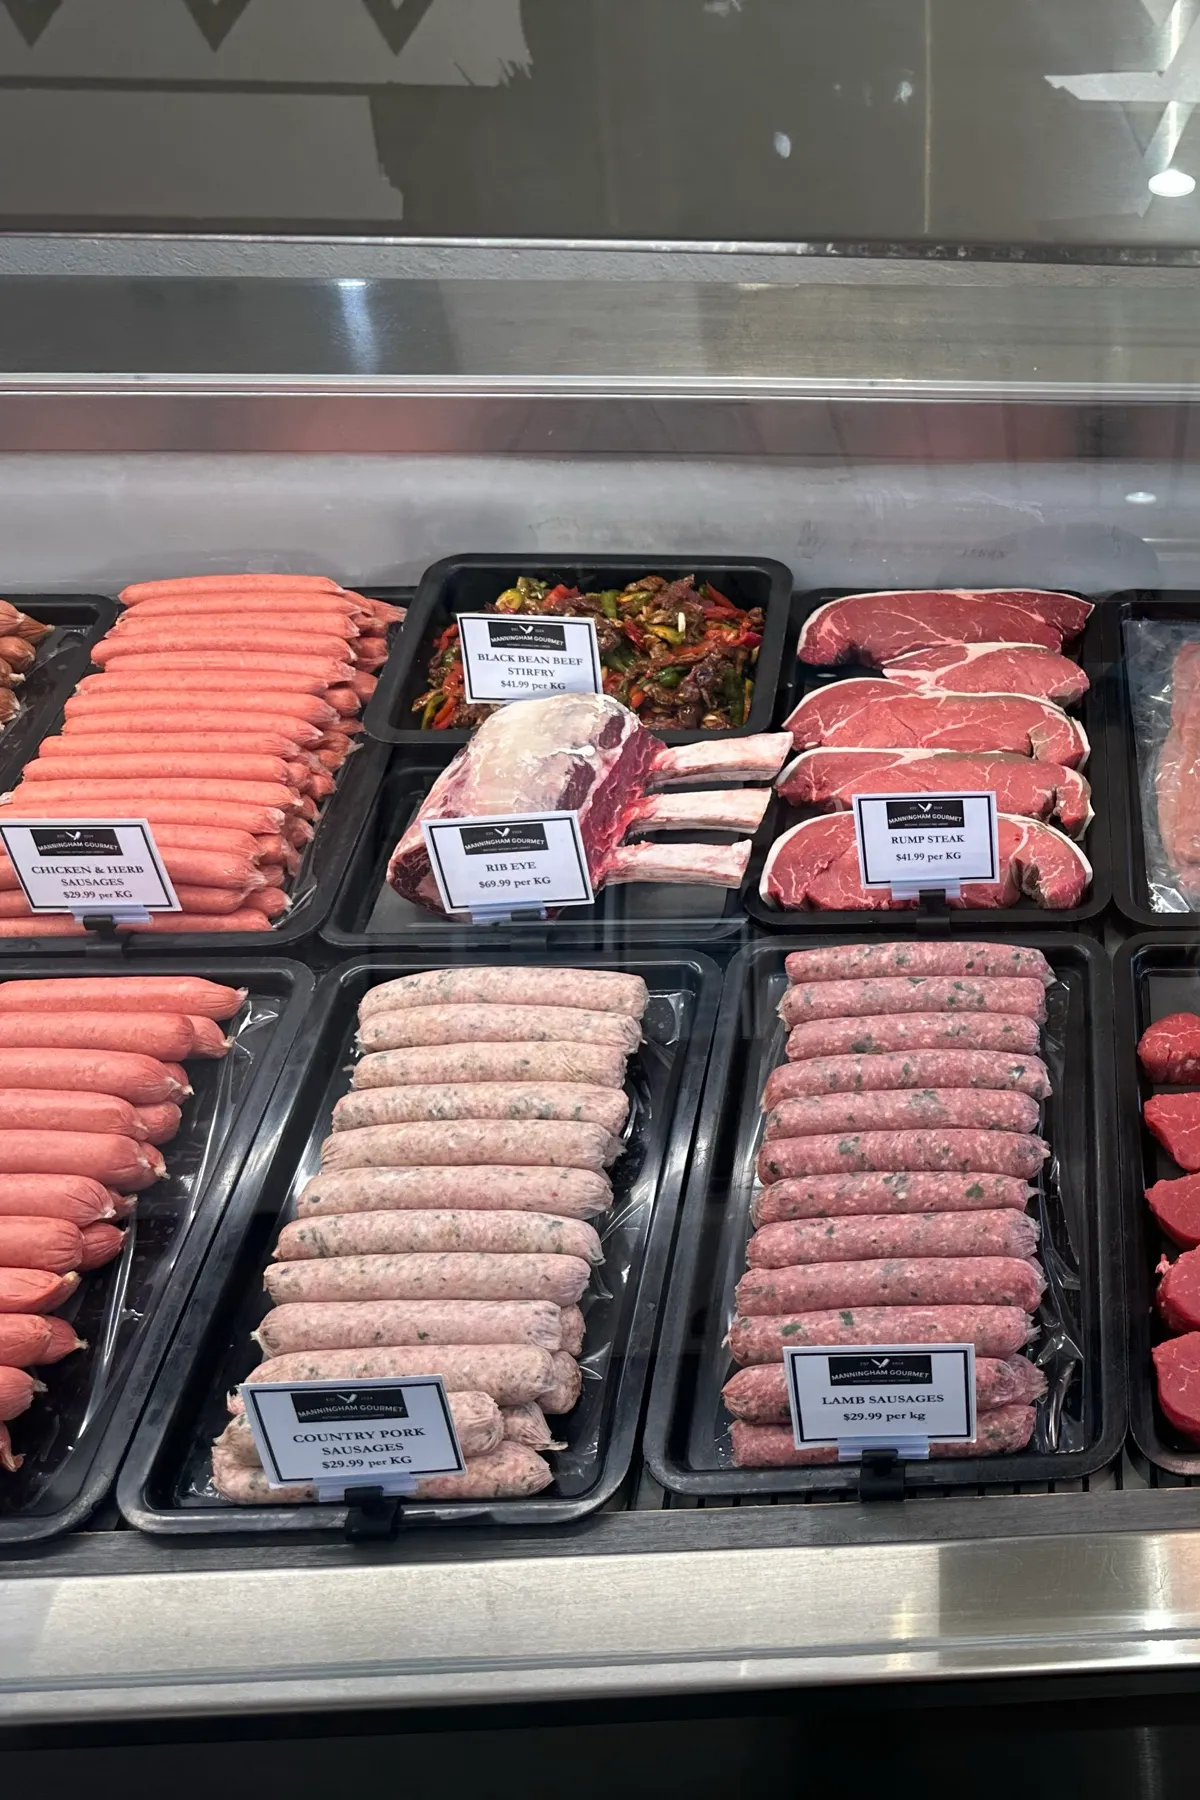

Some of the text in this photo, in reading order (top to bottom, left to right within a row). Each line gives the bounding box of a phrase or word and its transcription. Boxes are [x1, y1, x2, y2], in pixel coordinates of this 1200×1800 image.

[490, 635, 533, 643] MANNINGHAM
[534, 636, 564, 646] GOURMET
[477, 653, 583, 666] BLACK BEAN BEEF
[508, 667, 555, 677] STIRFRY
[500, 680, 530, 688] $41.99
[550, 682, 566, 690] KG
[888, 814, 962, 824] MANNINGHAM GOURMET
[464, 838, 511, 850] MANNINGHAM
[891, 834, 965, 844] RUMP STEAK
[38, 842, 118, 851] MANNINGHAM GOURMET
[928, 854, 943, 862] per
[946, 852, 962, 860] KG
[32, 866, 144, 874] CHICKEN & HERB
[486, 861, 537, 872] RIB EYE
[61, 878, 124, 886] SAUSAGES
[479, 876, 551, 889] $69.99 per KG
[63, 890, 133, 900] $29.99 per KG
[831, 1370, 929, 1380] MANNINGHAM GOURMET
[822, 1394, 944, 1405] LAMB SAUSAGES
[298, 1405, 358, 1418] MANNINGHAM
[360, 1405, 403, 1413] GOURMET
[843, 1412, 926, 1422] $29.99 per kg
[293, 1428, 426, 1443] COUNTRY PORK
[322, 1443, 404, 1456] SAUSAGES
[322, 1456, 412, 1469] $29.99 per KG
